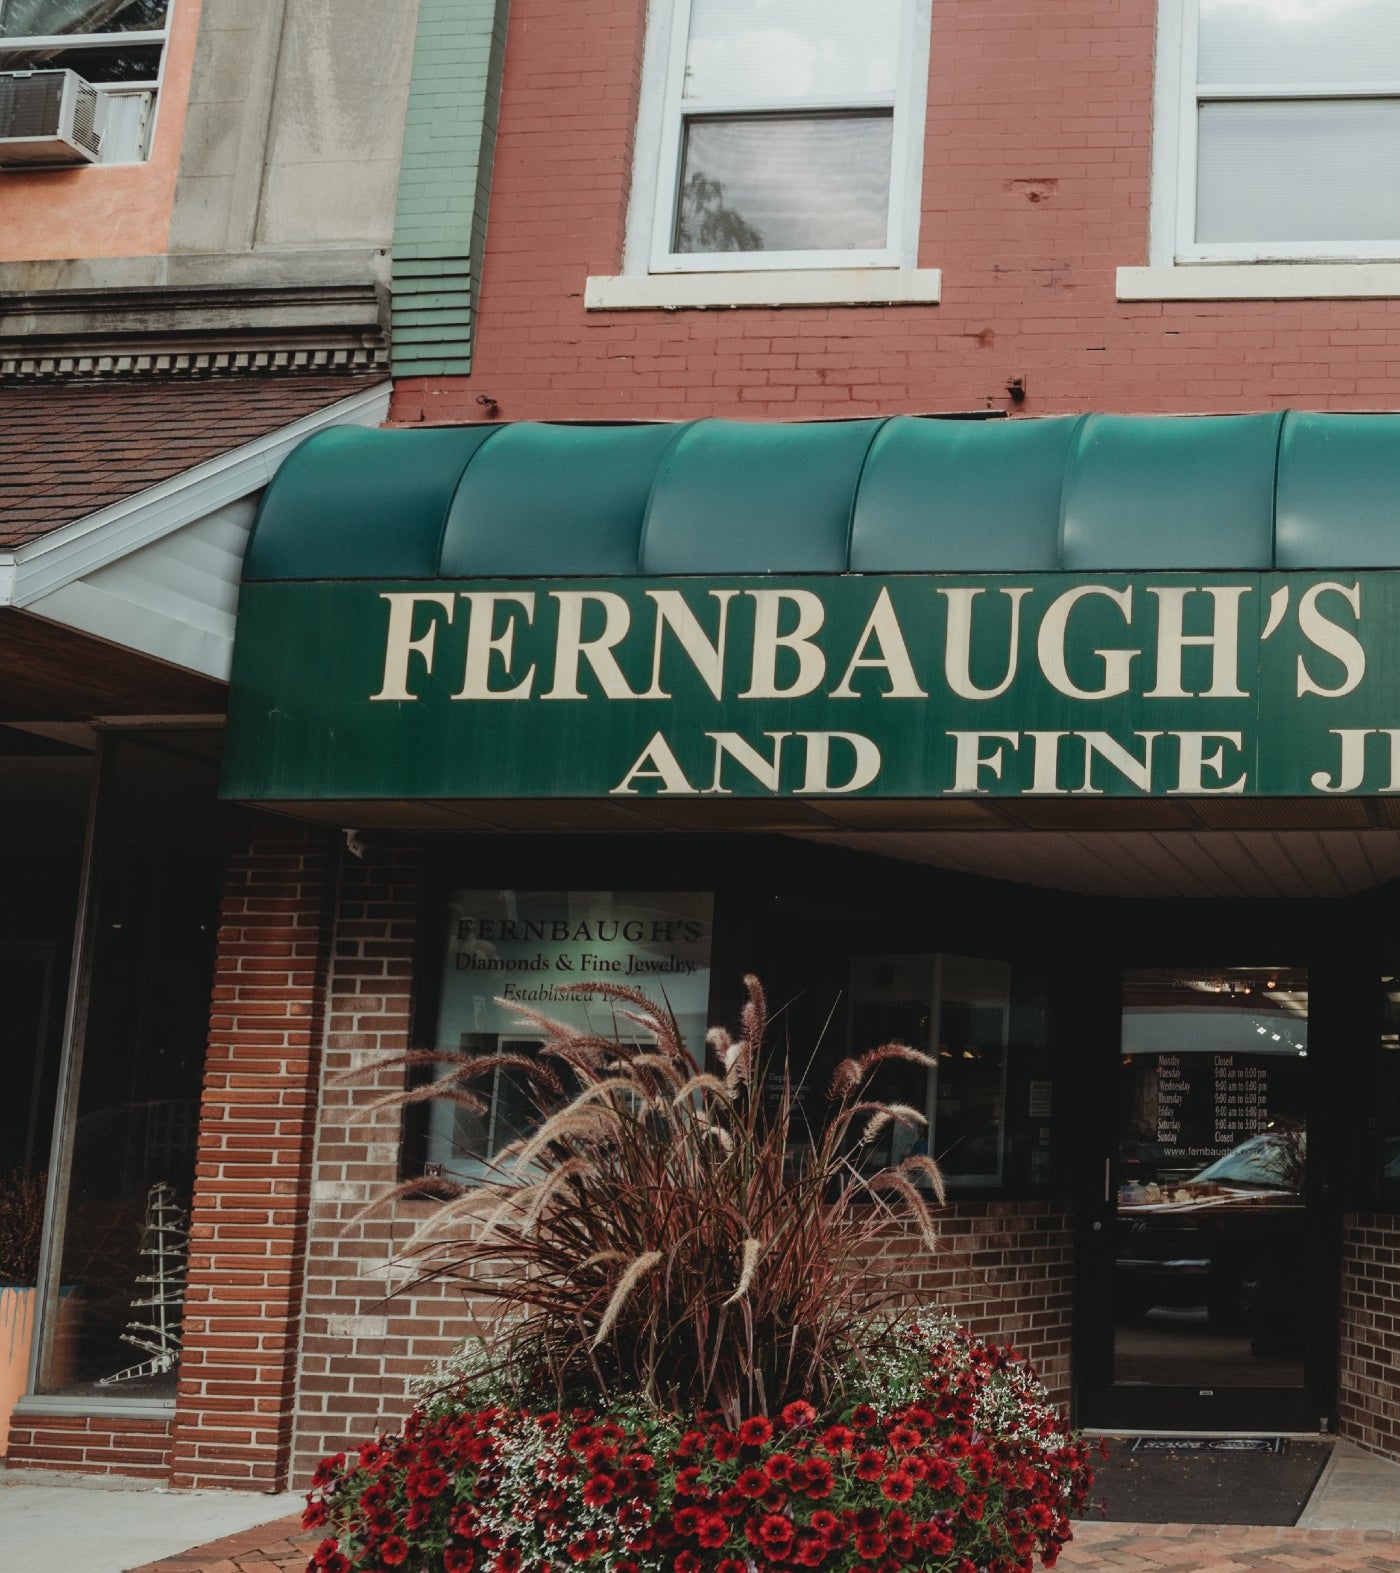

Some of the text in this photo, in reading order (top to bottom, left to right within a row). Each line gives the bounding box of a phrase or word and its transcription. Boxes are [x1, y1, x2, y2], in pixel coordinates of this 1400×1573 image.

[370, 581, 1366, 701] FERNBAUGH'S
[609, 731, 882, 796] AND
[943, 730, 1247, 794] FINE
[455, 919, 702, 942] FERNBAUGH'S
[454, 953, 549, 972] Diamonds
[555, 953, 575, 972] &
[580, 953, 621, 972] Fine
[1158, 1055, 1233, 1067] Monday Closed
[1158, 1067, 1181, 1079] Tuesday
[1258, 1070, 1267, 1080] pm
[1160, 1080, 1190, 1093] Wednesday
[1258, 1083, 1268, 1094] pm
[1159, 1093, 1183, 1106] Thursday
[1258, 1096, 1267, 1106] pm
[1158, 1106, 1174, 1118] Friday
[1258, 1109, 1268, 1119] pm
[1157, 1118, 1182, 1132] Saturday
[1258, 1121, 1267, 1132] pm
[1157, 1131, 1234, 1144] Sunday Closed
